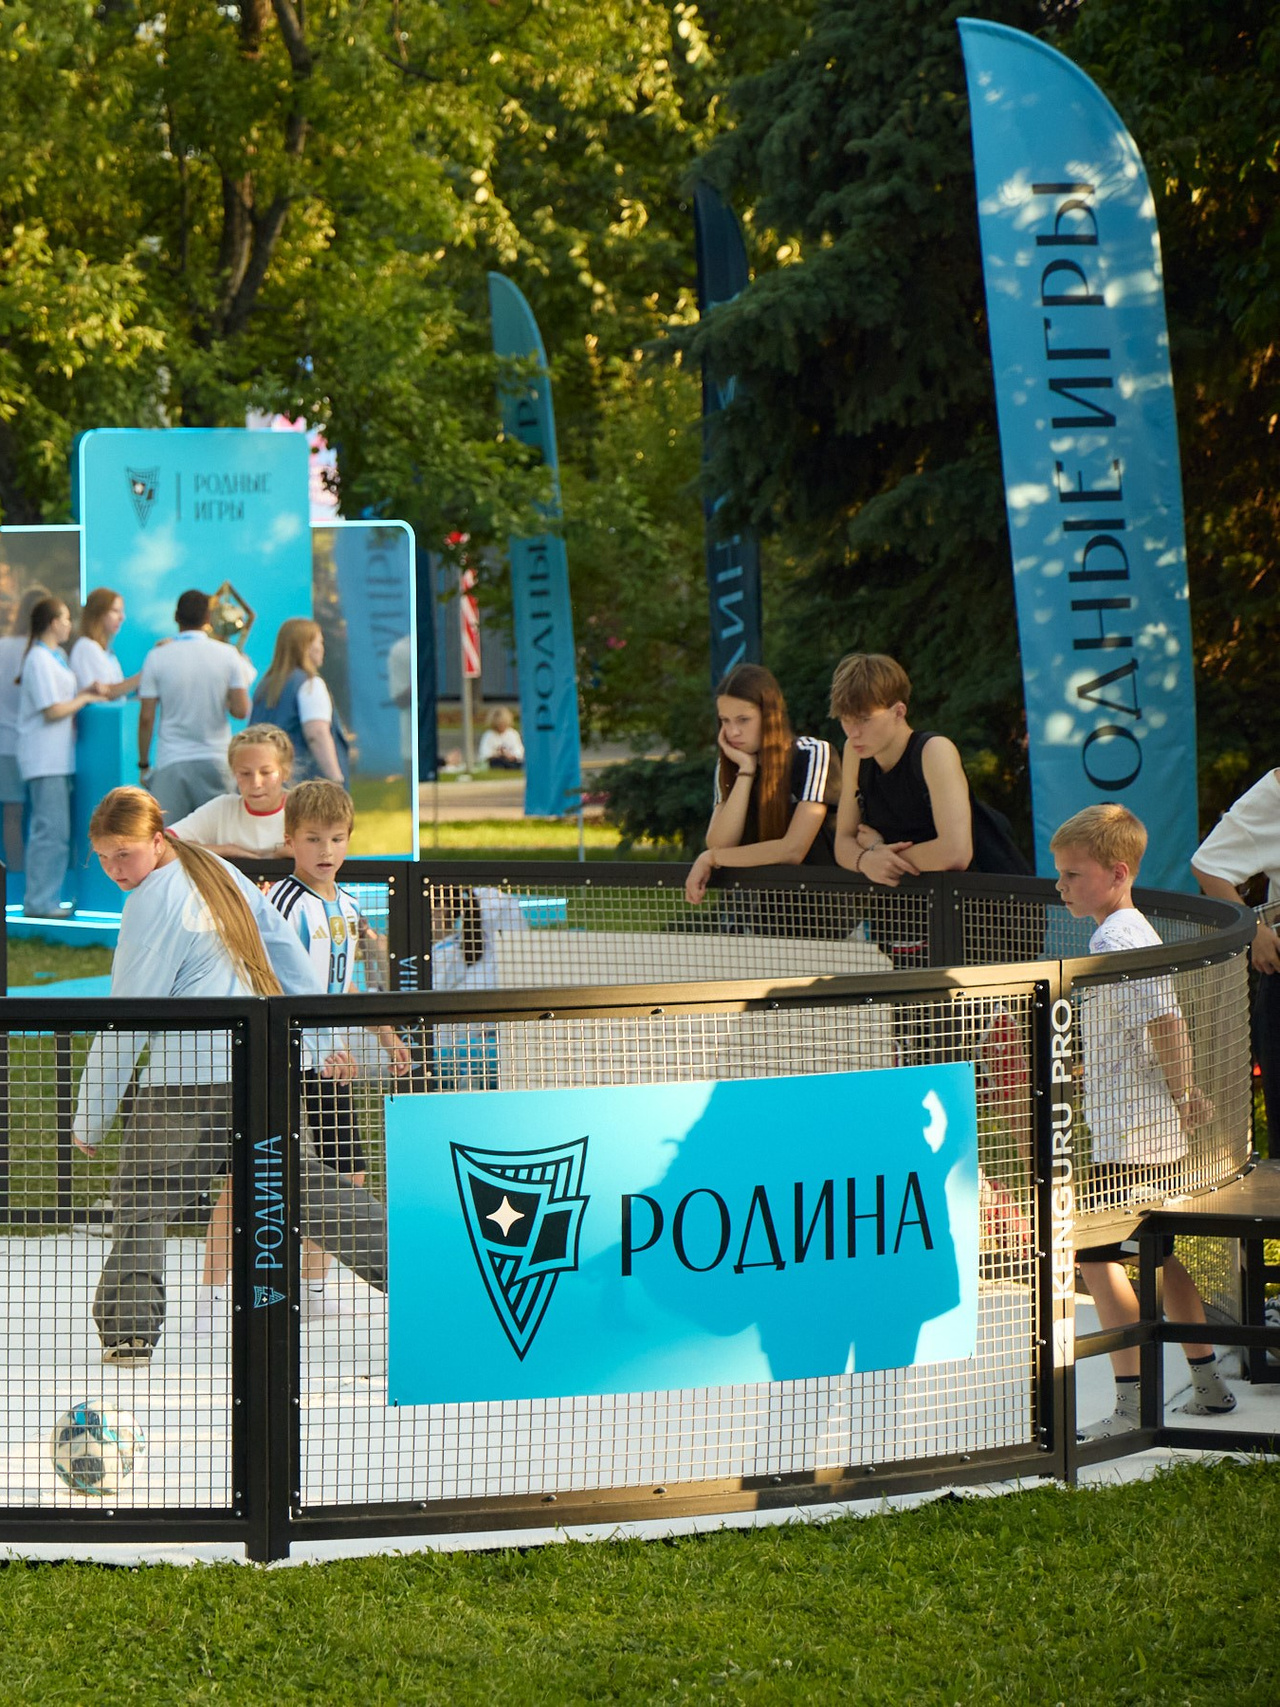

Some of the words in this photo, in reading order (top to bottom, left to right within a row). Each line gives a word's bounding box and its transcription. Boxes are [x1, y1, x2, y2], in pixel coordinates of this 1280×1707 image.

[1031, 182, 1117, 430] ИГРЫ
[193, 471, 271, 495] РОДНЫЕ
[193, 500, 244, 522] ИГРЫ
[527, 544, 555, 732] РОДНЫ
[1054, 458, 1143, 792] ОДНЫЕ
[1051, 998, 1072, 1084] PRO
[253, 1135, 285, 1269] РОДИНА
[620, 1171, 936, 1278] РОДИНА
[1051, 1103, 1073, 1299] KENGURU
